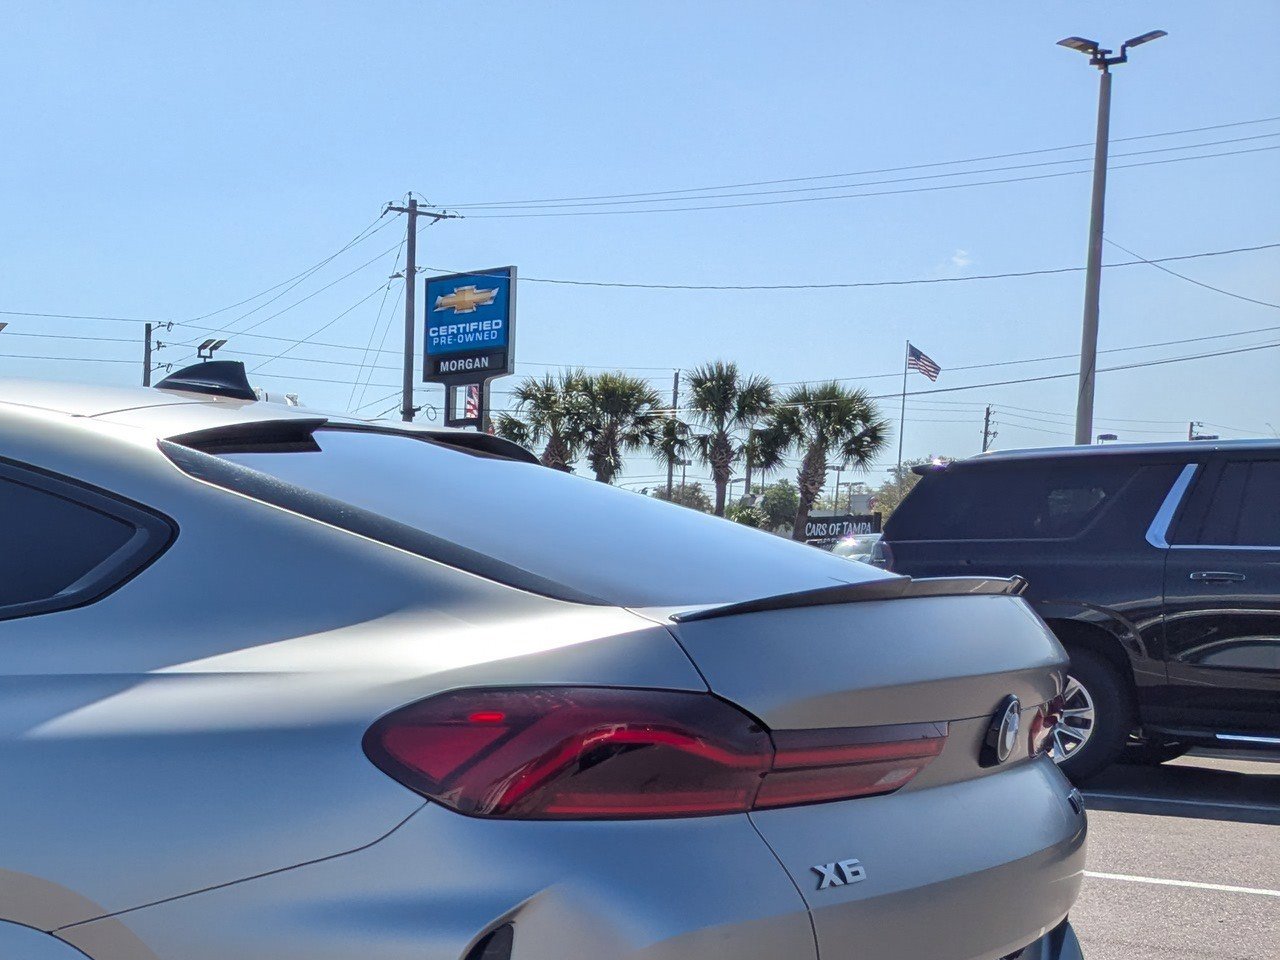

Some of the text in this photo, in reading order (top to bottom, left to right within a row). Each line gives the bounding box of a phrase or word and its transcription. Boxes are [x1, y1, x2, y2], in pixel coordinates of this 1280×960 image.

[429, 319, 503, 337] CERTIFIED
[433, 330, 498, 346] PRE-OWNED
[440, 357, 489, 372] MORGAN
[805, 521, 872, 537] CARS OF TAMPA
[810, 858, 867, 890] X6
